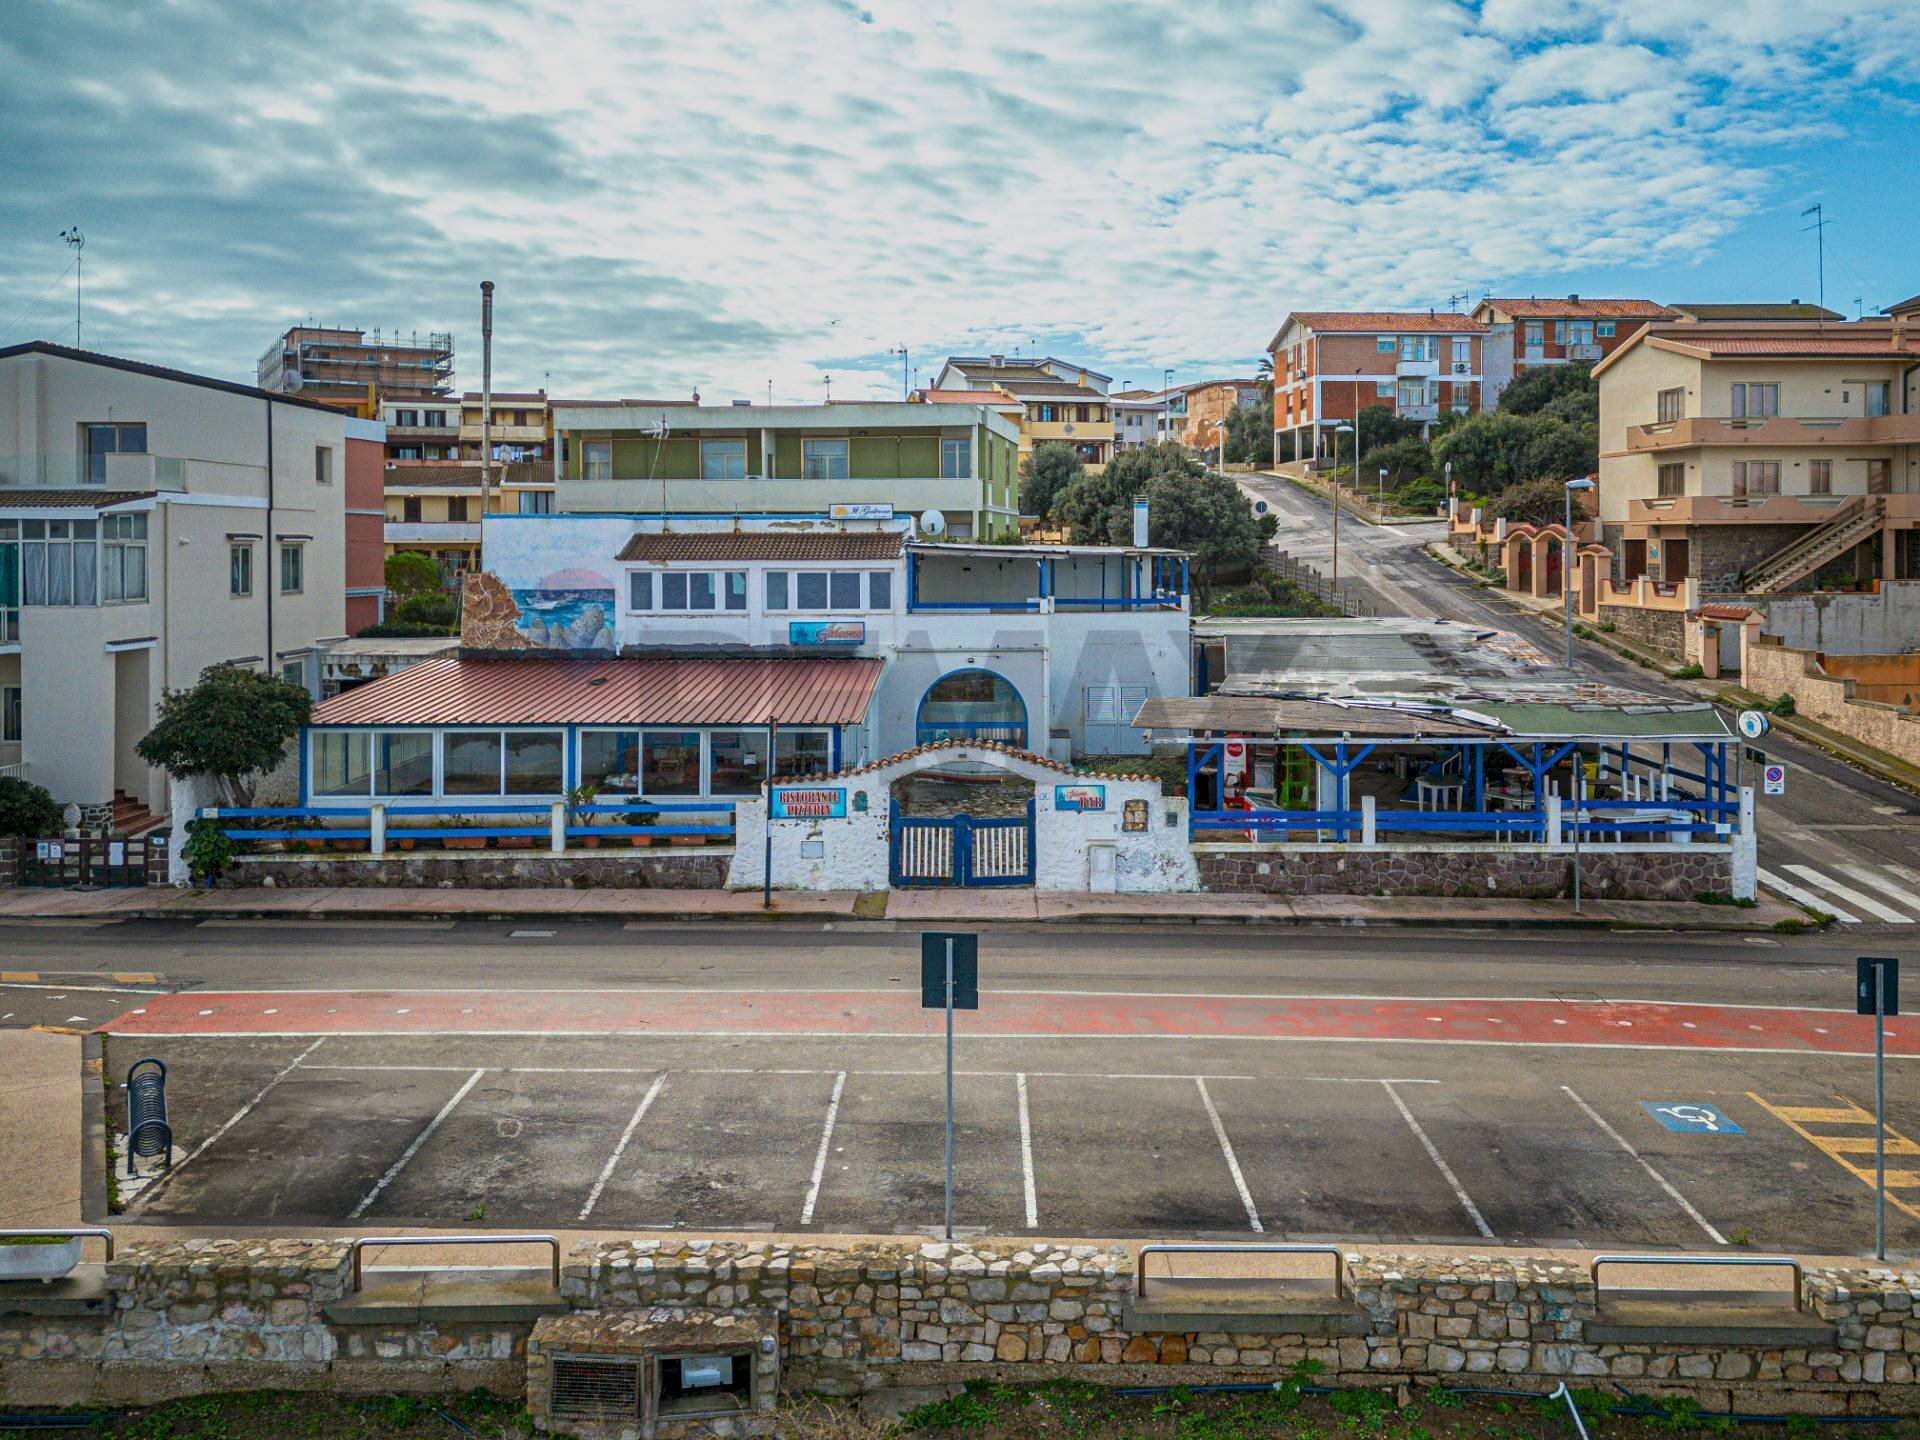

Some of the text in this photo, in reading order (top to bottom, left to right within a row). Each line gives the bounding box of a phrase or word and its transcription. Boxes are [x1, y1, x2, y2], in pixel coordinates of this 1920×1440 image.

[779, 791, 841, 803] RISTORANTE
[1080, 796, 1102, 808] BAR
[787, 804, 830, 816] PIZZERIA
